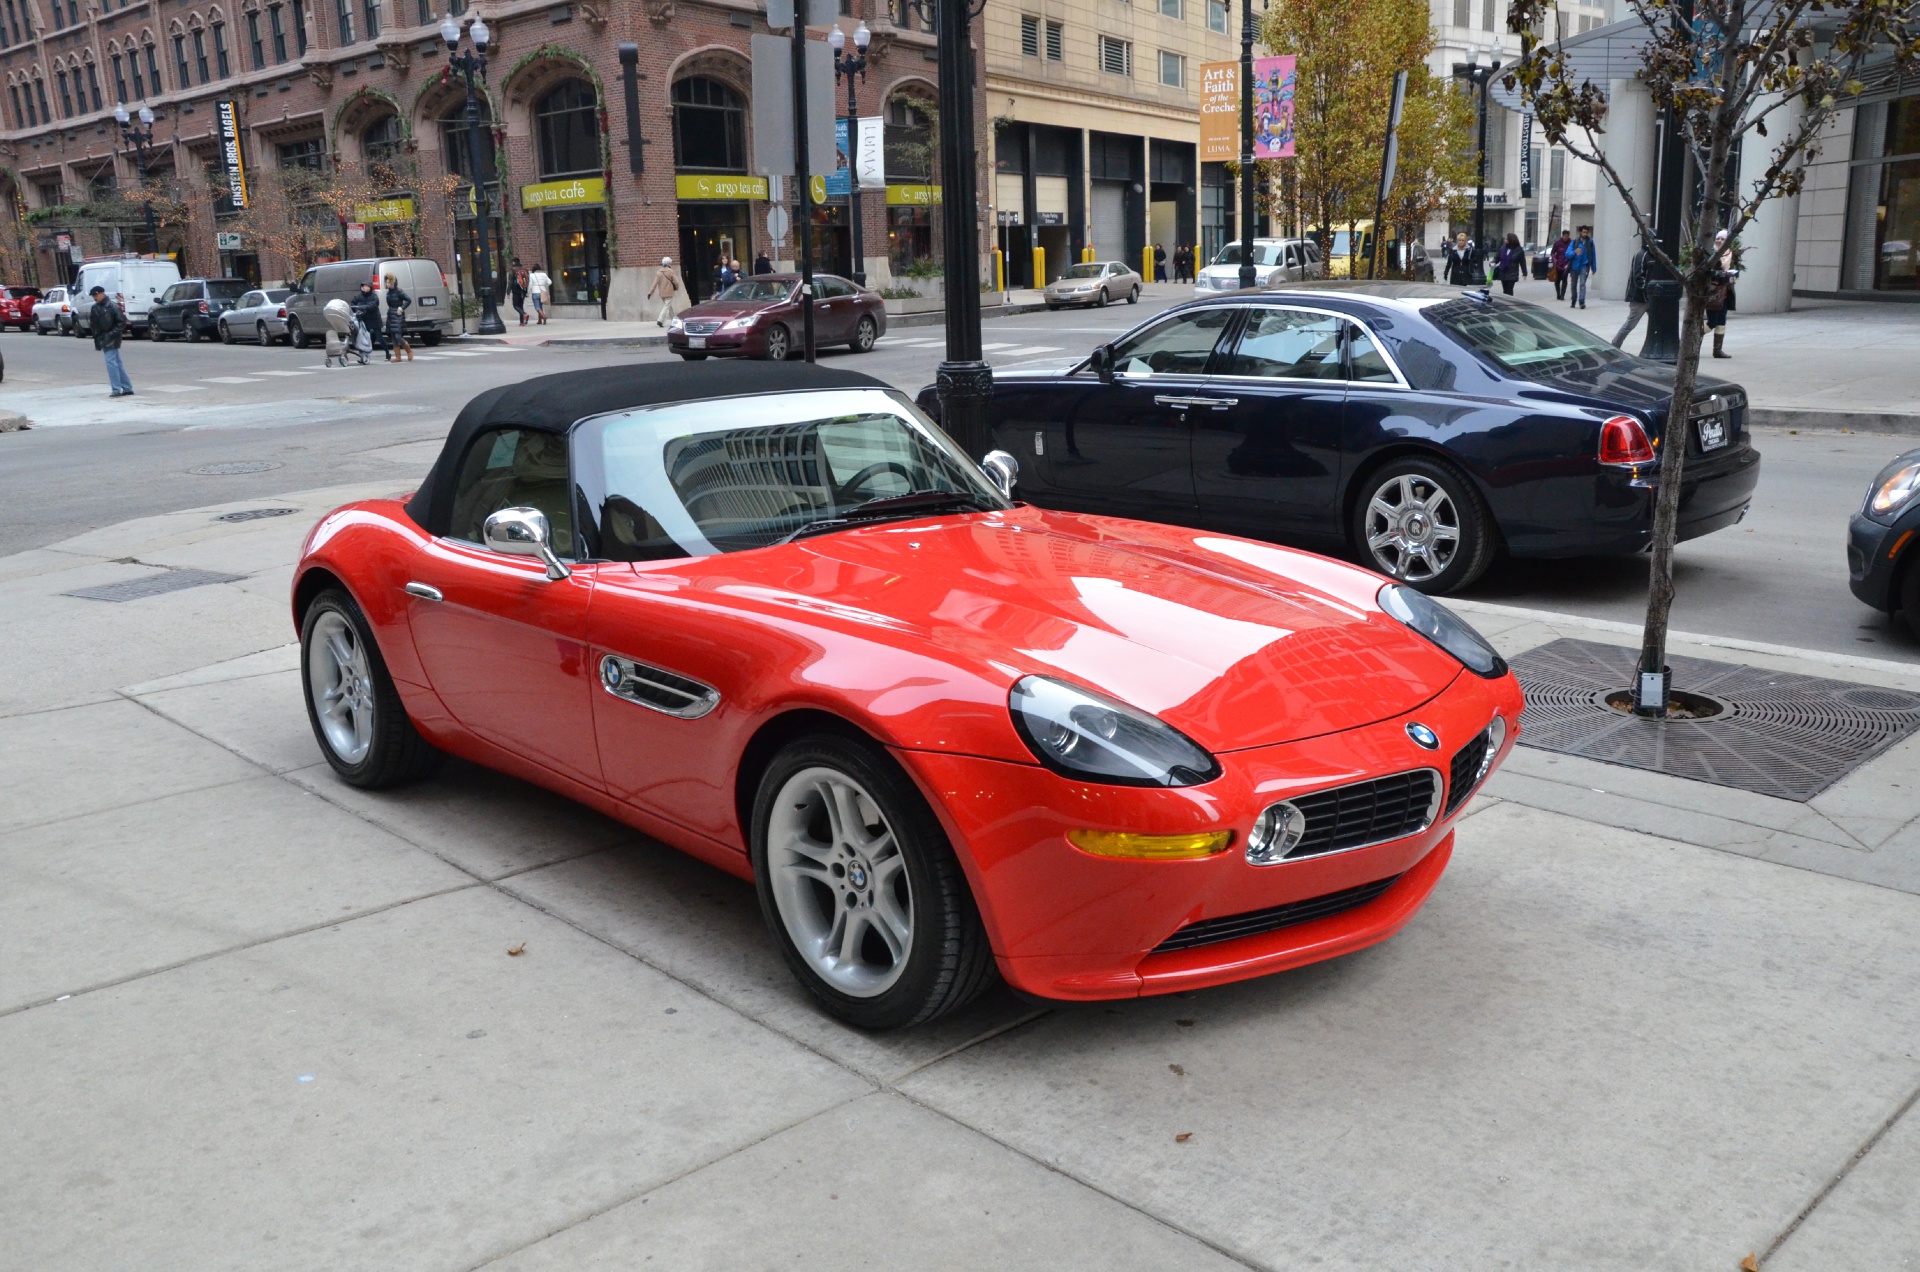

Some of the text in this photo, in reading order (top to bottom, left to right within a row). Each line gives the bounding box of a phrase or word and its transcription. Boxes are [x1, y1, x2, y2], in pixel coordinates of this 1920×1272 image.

[1204, 68, 1235, 80] Art &
[1204, 79, 1234, 93] Faith
[1209, 93, 1229, 104] of the
[1202, 102, 1236, 113] Creche
[220, 103, 244, 206] EINSTEIN BROS. BAGELS
[864, 126, 876, 176] LUMA
[1207, 145, 1230, 153] LUMA
[1521, 161, 1531, 184] rack
[530, 181, 585, 205] argo tea café
[715, 178, 764, 197] argo tea café
